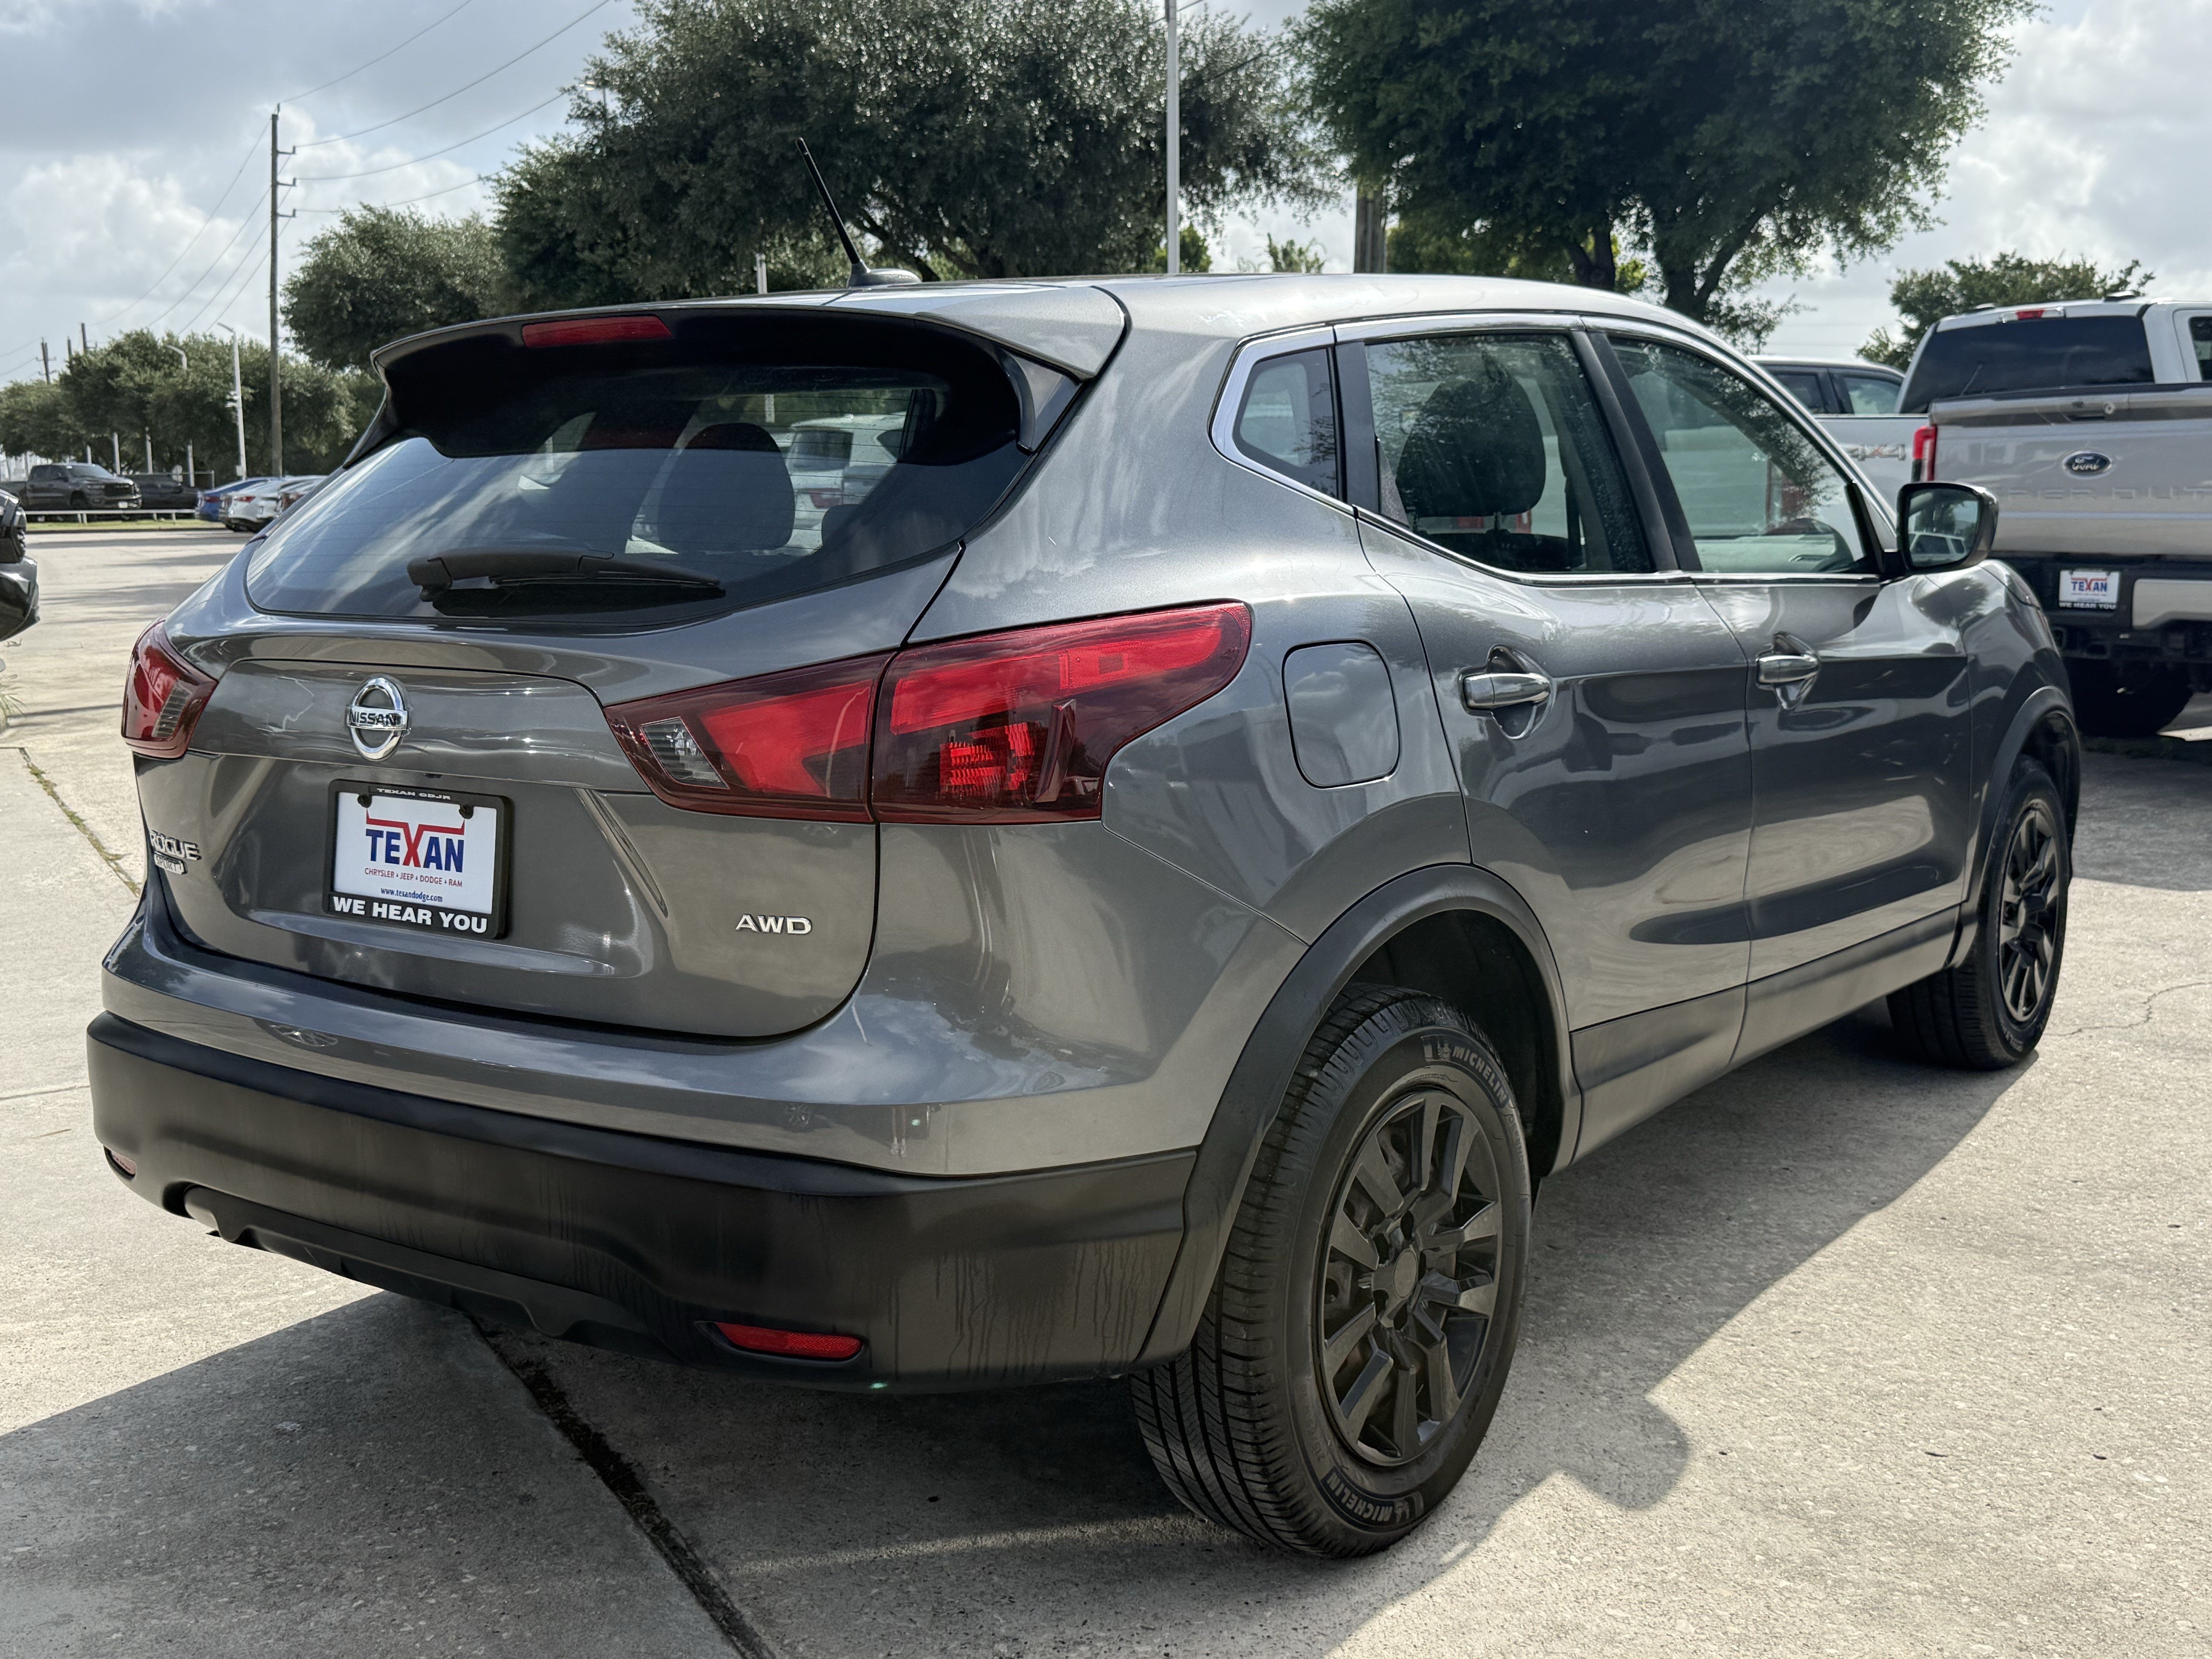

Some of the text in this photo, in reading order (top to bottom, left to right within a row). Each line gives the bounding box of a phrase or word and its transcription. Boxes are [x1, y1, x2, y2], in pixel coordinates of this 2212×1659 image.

[2112, 486, 2212, 500] DUT
[2071, 577, 2107, 592] TEXAN
[349, 711, 402, 726] NISSAN
[377, 788, 416, 797] TEXAN
[149, 830, 202, 861] ROGUE
[365, 813, 465, 873] TEXAN
[364, 867, 463, 888] CHRYSLER JEEP DODGE RAM
[381, 887, 443, 903] www.texandodge.com
[333, 896, 487, 933] WE HEAR YOU
[735, 914, 812, 935] AWD
[1452, 1046, 1508, 1104] MICHELIN
[1326, 1472, 1393, 1522] MICHELIN
